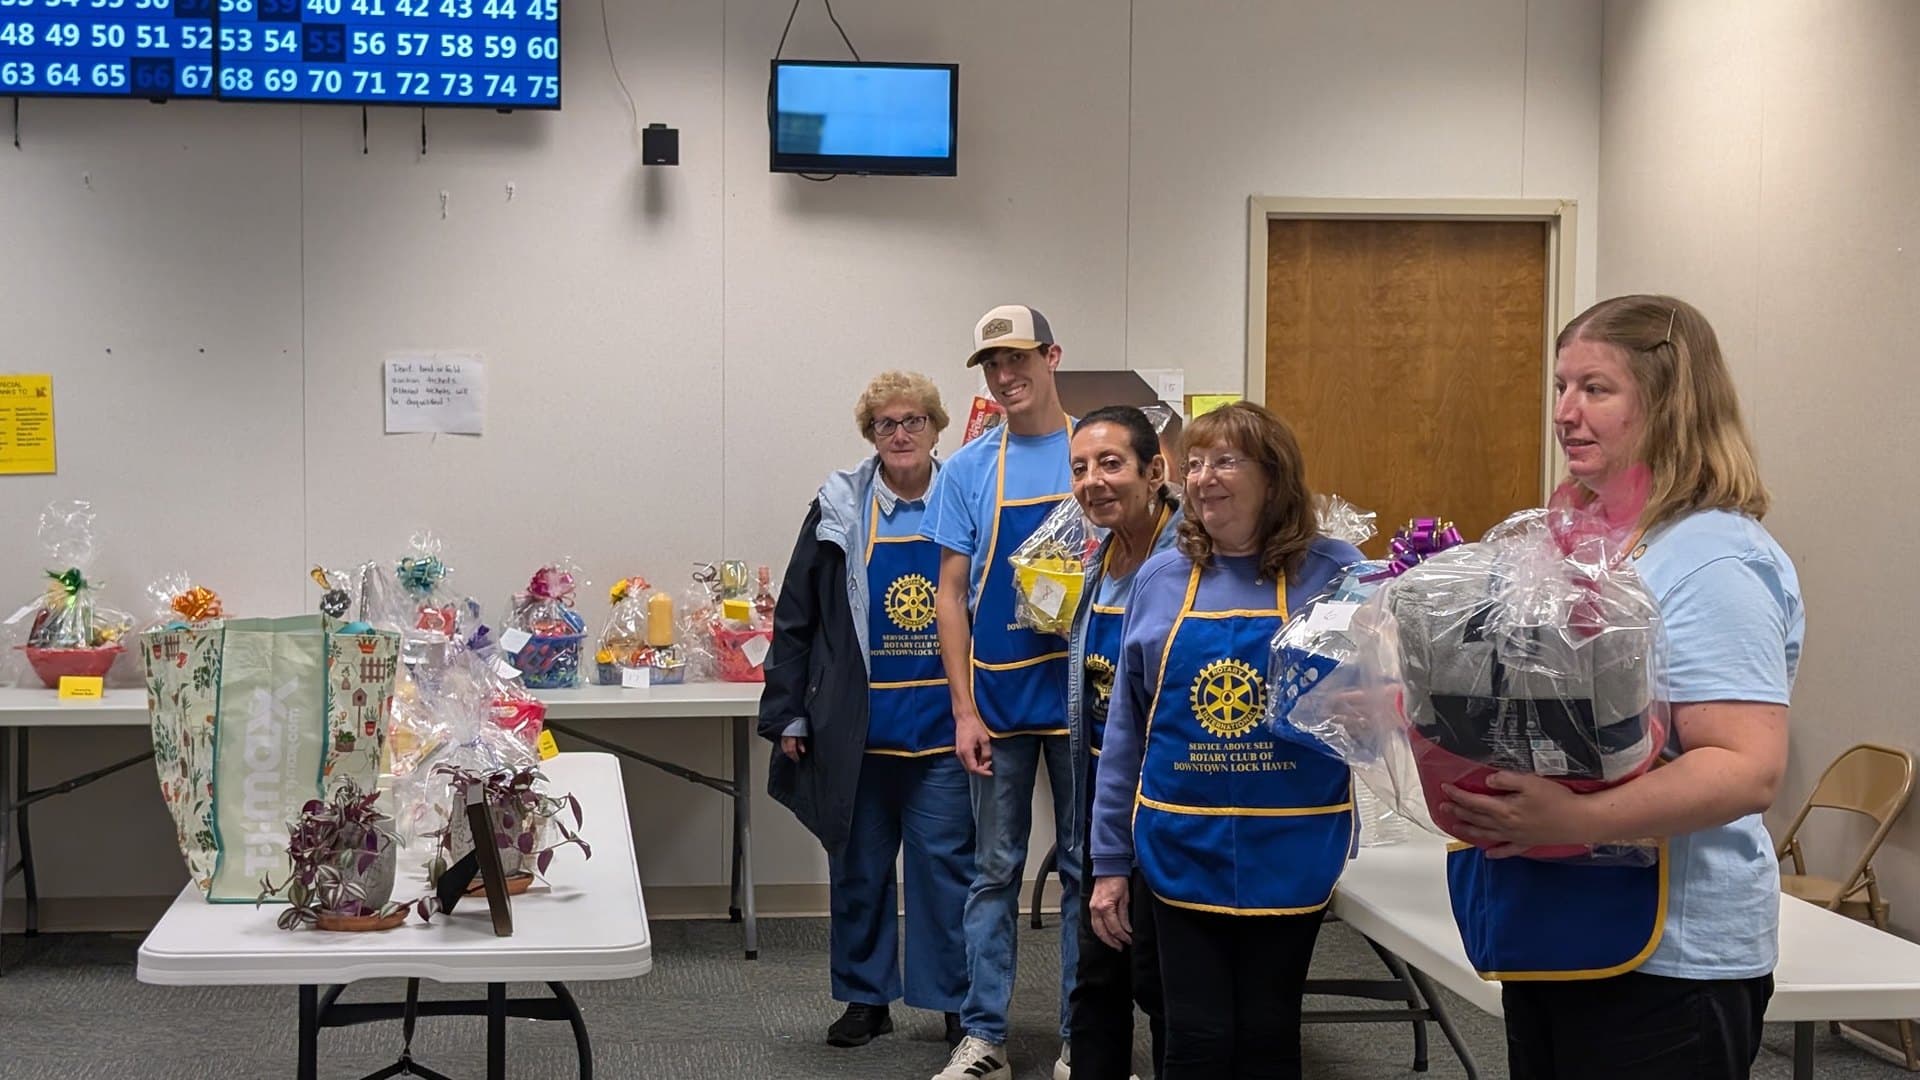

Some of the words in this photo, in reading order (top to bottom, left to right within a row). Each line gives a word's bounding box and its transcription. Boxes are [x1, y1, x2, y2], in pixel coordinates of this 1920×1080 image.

[307, 0, 341, 15] 40
[352, 0, 385, 16] 41
[396, 0, 429, 17] 42
[439, 0, 473, 18] 43
[483, 0, 517, 19] 44
[527, 0, 558, 20] 45
[1, 23, 35, 46] 48
[46, 24, 80, 46] 49
[91, 25, 125, 47] 50
[136, 26, 170, 48] 51
[181, 26, 212, 49] 52
[220, 29, 252, 51] 53
[264, 30, 297, 52] 54
[353, 32, 386, 55] 56
[397, 33, 429, 56] 57
[440, 34, 473, 57] 58
[484, 36, 517, 58] 59
[527, 37, 558, 59] 60
[2, 63, 35, 85] 63
[46, 64, 81, 86] 64
[92, 64, 125, 87] 65
[181, 66, 212, 88] 67
[220, 68, 253, 90] 68
[264, 69, 298, 91] 69
[308, 70, 342, 93] 70
[352, 71, 386, 94] 71
[396, 73, 430, 95] 72
[440, 74, 474, 96] 73
[484, 75, 517, 97] 74
[527, 76, 558, 98] 75
[883, 641, 912, 649] ROTARY
[1211, 665, 1245, 676] ROTARY
[1201, 709, 1257, 731] INTERNATIONAL
[1189, 742, 1221, 751] SERVICE
[1223, 742, 1252, 751] ABOVE
[1254, 741, 1274, 750] SELF
[1174, 762, 1228, 772] DOWNTOWN
[1231, 763, 1260, 772] LOCK
[1262, 761, 1297, 771] HAVEN
[1190, 752, 1227, 762] ROTARY
[1230, 752, 1257, 762] CLUB
[1259, 751, 1275, 761] OF
